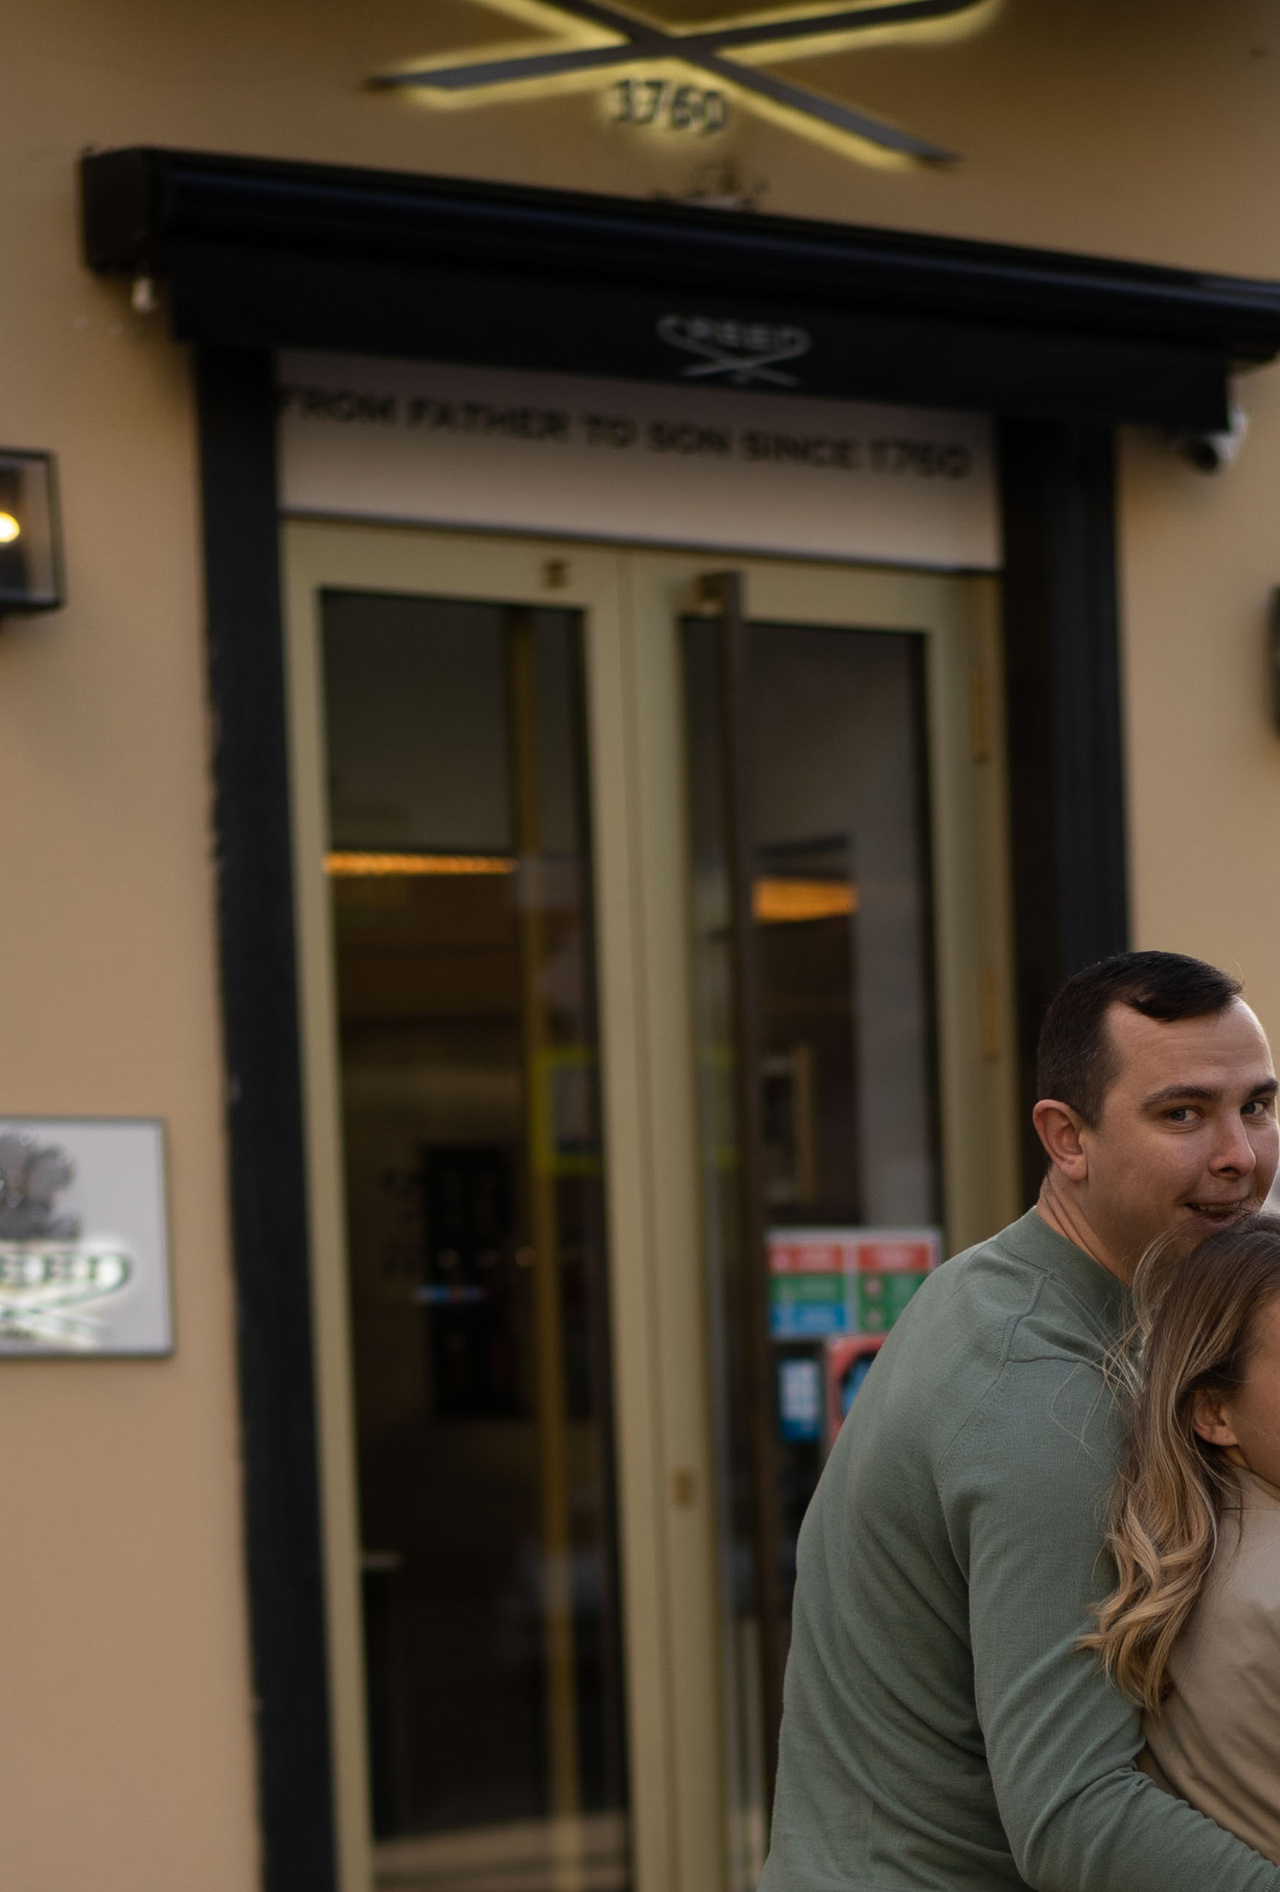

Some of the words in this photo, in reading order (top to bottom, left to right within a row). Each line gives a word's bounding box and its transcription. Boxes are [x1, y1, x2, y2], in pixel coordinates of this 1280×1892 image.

[612, 78, 729, 135] 1760
[405, 396, 568, 443] FATHER
[580, 411, 637, 447] TO
[647, 421, 730, 457] SON
[741, 429, 857, 471] SINCE
